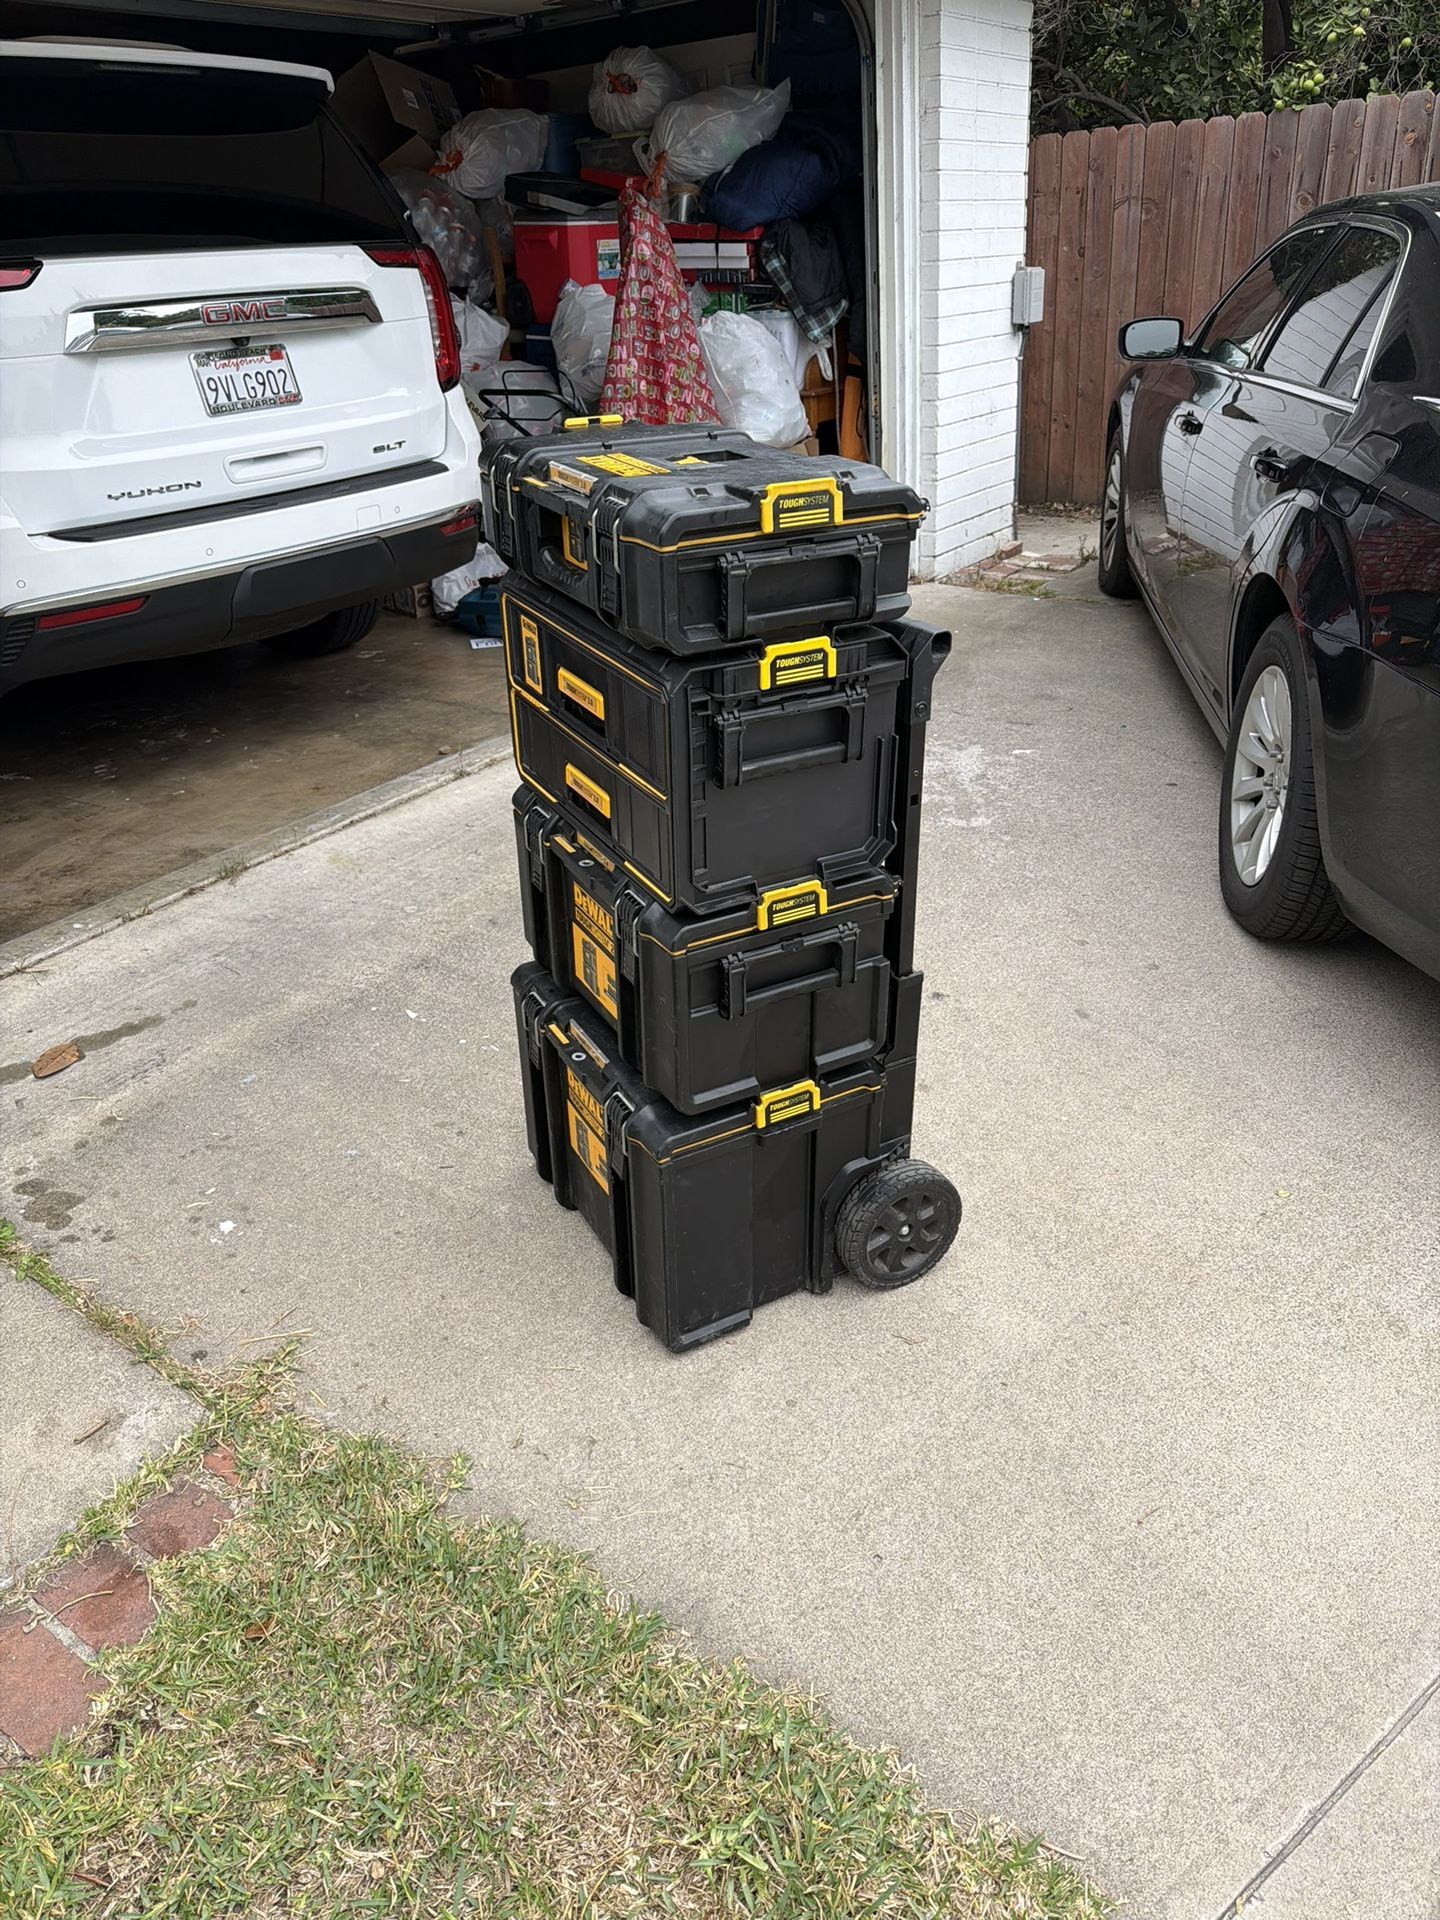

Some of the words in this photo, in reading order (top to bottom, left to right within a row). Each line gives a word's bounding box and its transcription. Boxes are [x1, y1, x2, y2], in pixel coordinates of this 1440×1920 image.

[202, 299, 288, 325] GMC
[214, 356, 272, 372] California
[206, 368, 292, 404] 9VLG902
[373, 440, 406, 454] SLT
[107, 481, 201, 500] YUKON
[779, 495, 829, 509] TOUGHSYSTEM
[776, 652, 824, 668] TOUGHSYSTEM
[574, 883, 614, 938] DEWAL
